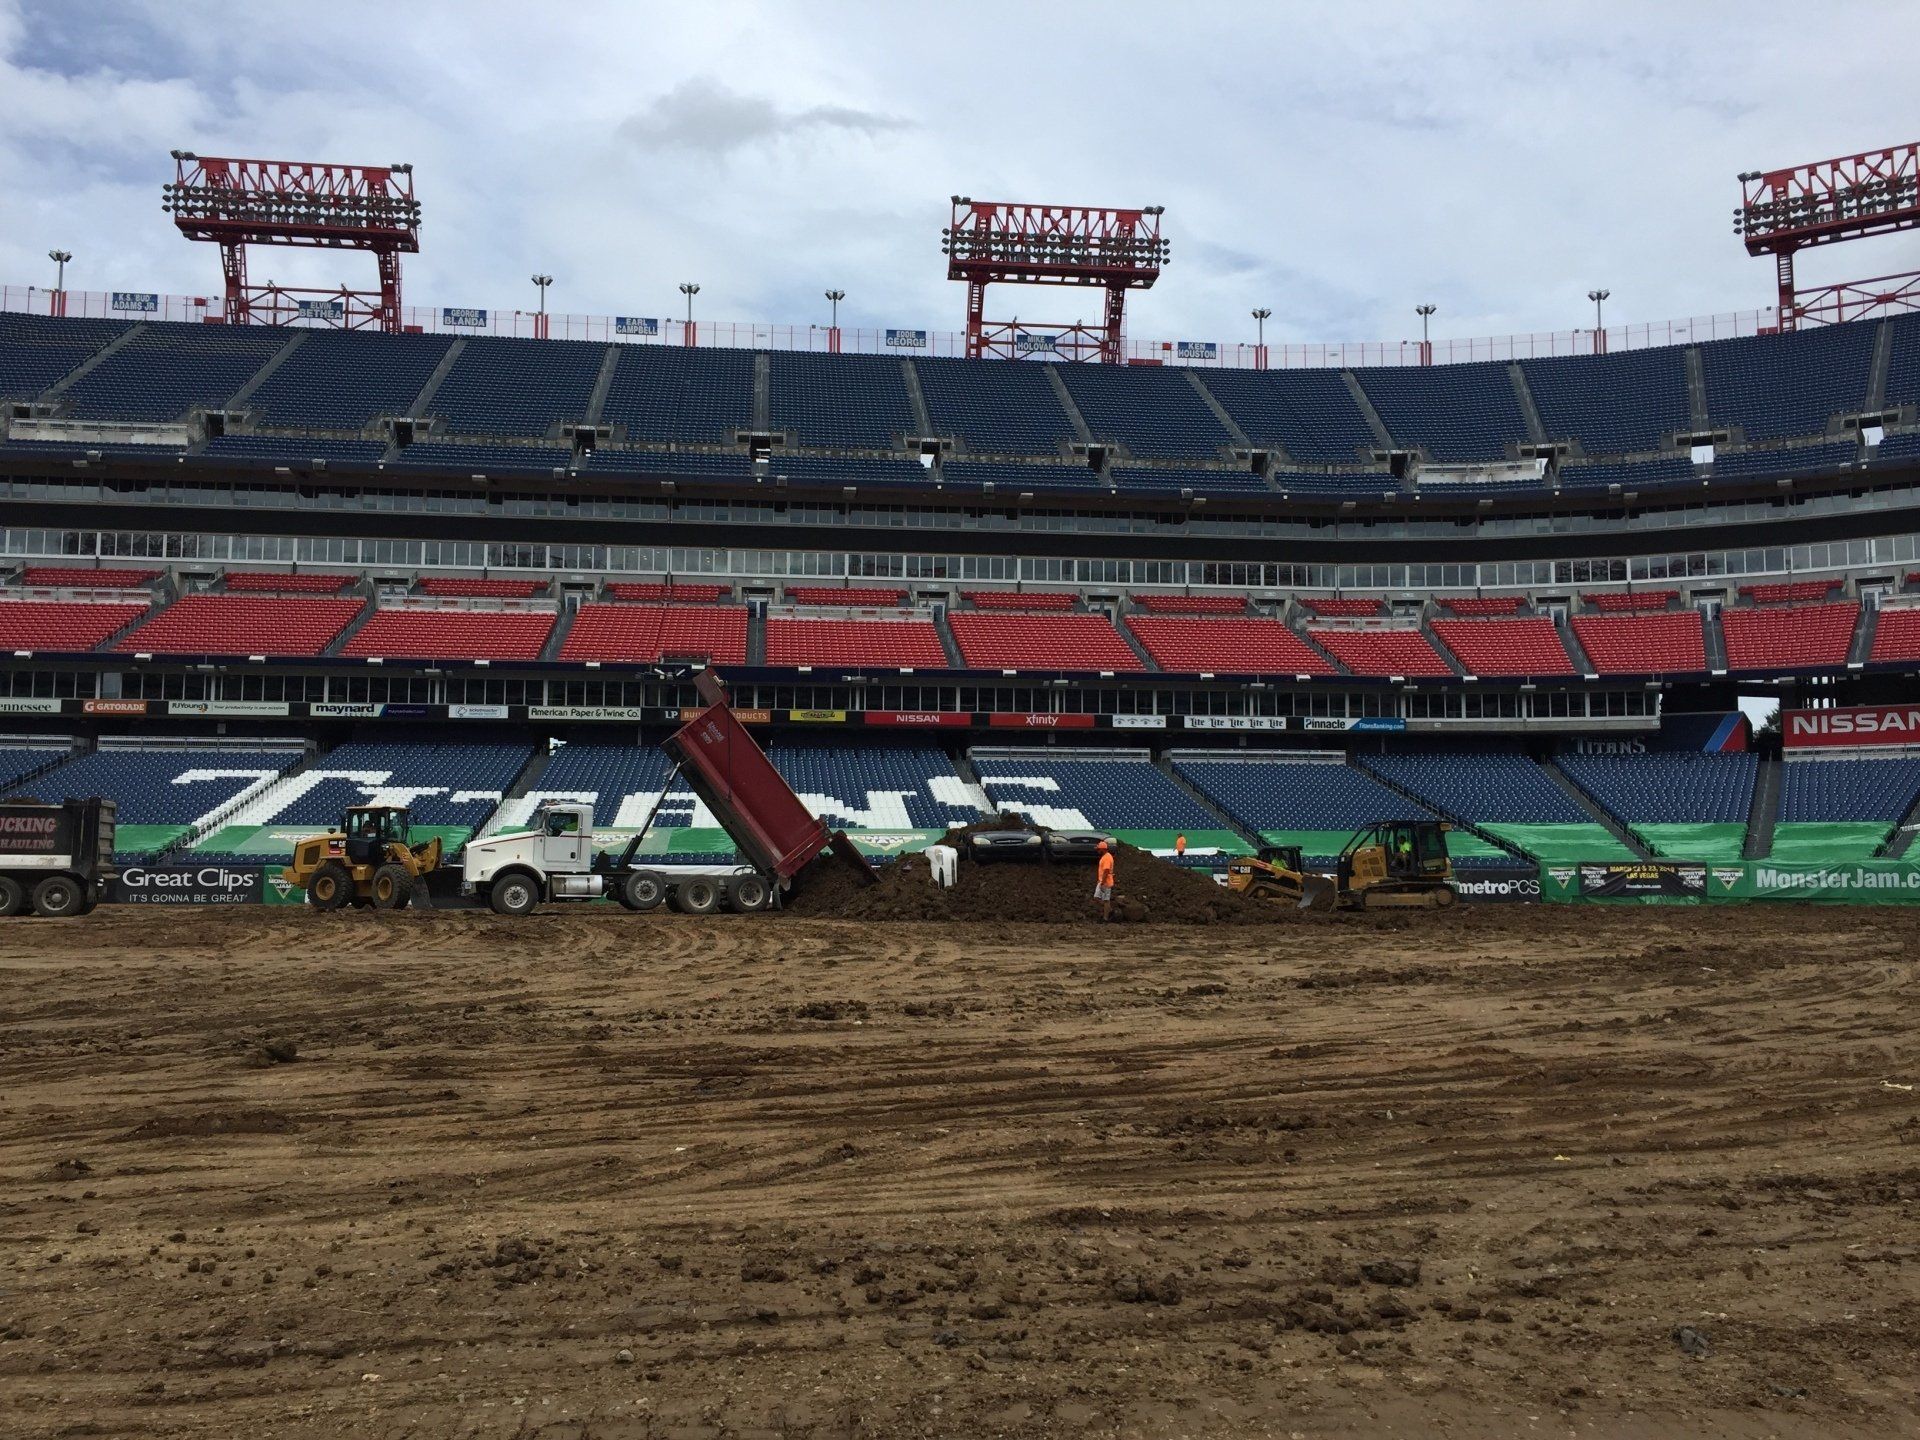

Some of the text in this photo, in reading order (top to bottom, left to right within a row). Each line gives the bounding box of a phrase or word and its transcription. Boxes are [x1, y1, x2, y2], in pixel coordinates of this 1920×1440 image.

[113, 302, 143, 310] ADAMS
[310, 302, 332, 310] ELVIN
[300, 309, 342, 319] BETHEA
[451, 309, 480, 318] GEORGE
[444, 317, 486, 327] BLANDA
[626, 318, 648, 326] EARL
[616, 325, 658, 335] CAMPBELL
[896, 330, 917, 338] EDDIE
[886, 338, 926, 347] GEORGE
[1027, 336, 1045, 344] MIKE
[1017, 342, 1054, 352] HOLOVAK
[1188, 342, 1206, 350] KEN
[1178, 350, 1216, 358] HOUSTON
[96, 702, 144, 711] GATORADE
[316, 704, 374, 714] maynard
[531, 708, 568, 717] American
[570, 708, 595, 718] Paper
[602, 709, 625, 718] Twine
[665, 710, 678, 718] LP
[896, 714, 940, 723] NISSAN
[1026, 714, 1059, 726] xfinity
[1190, 718, 1284, 728] Lite Lite Lite Lite Lite
[1793, 712, 1920, 734] NISSAN
[1305, 718, 1346, 729] Pinnacle
[1571, 736, 1646, 754] TITANS
[1240, 866, 1251, 874] CAT
[122, 868, 254, 892] Great Clips
[1756, 868, 1920, 889] MonsterJam.c
[1458, 879, 1540, 894] metroPCS
[129, 894, 244, 902] IT'S GONNA BE GREAT
